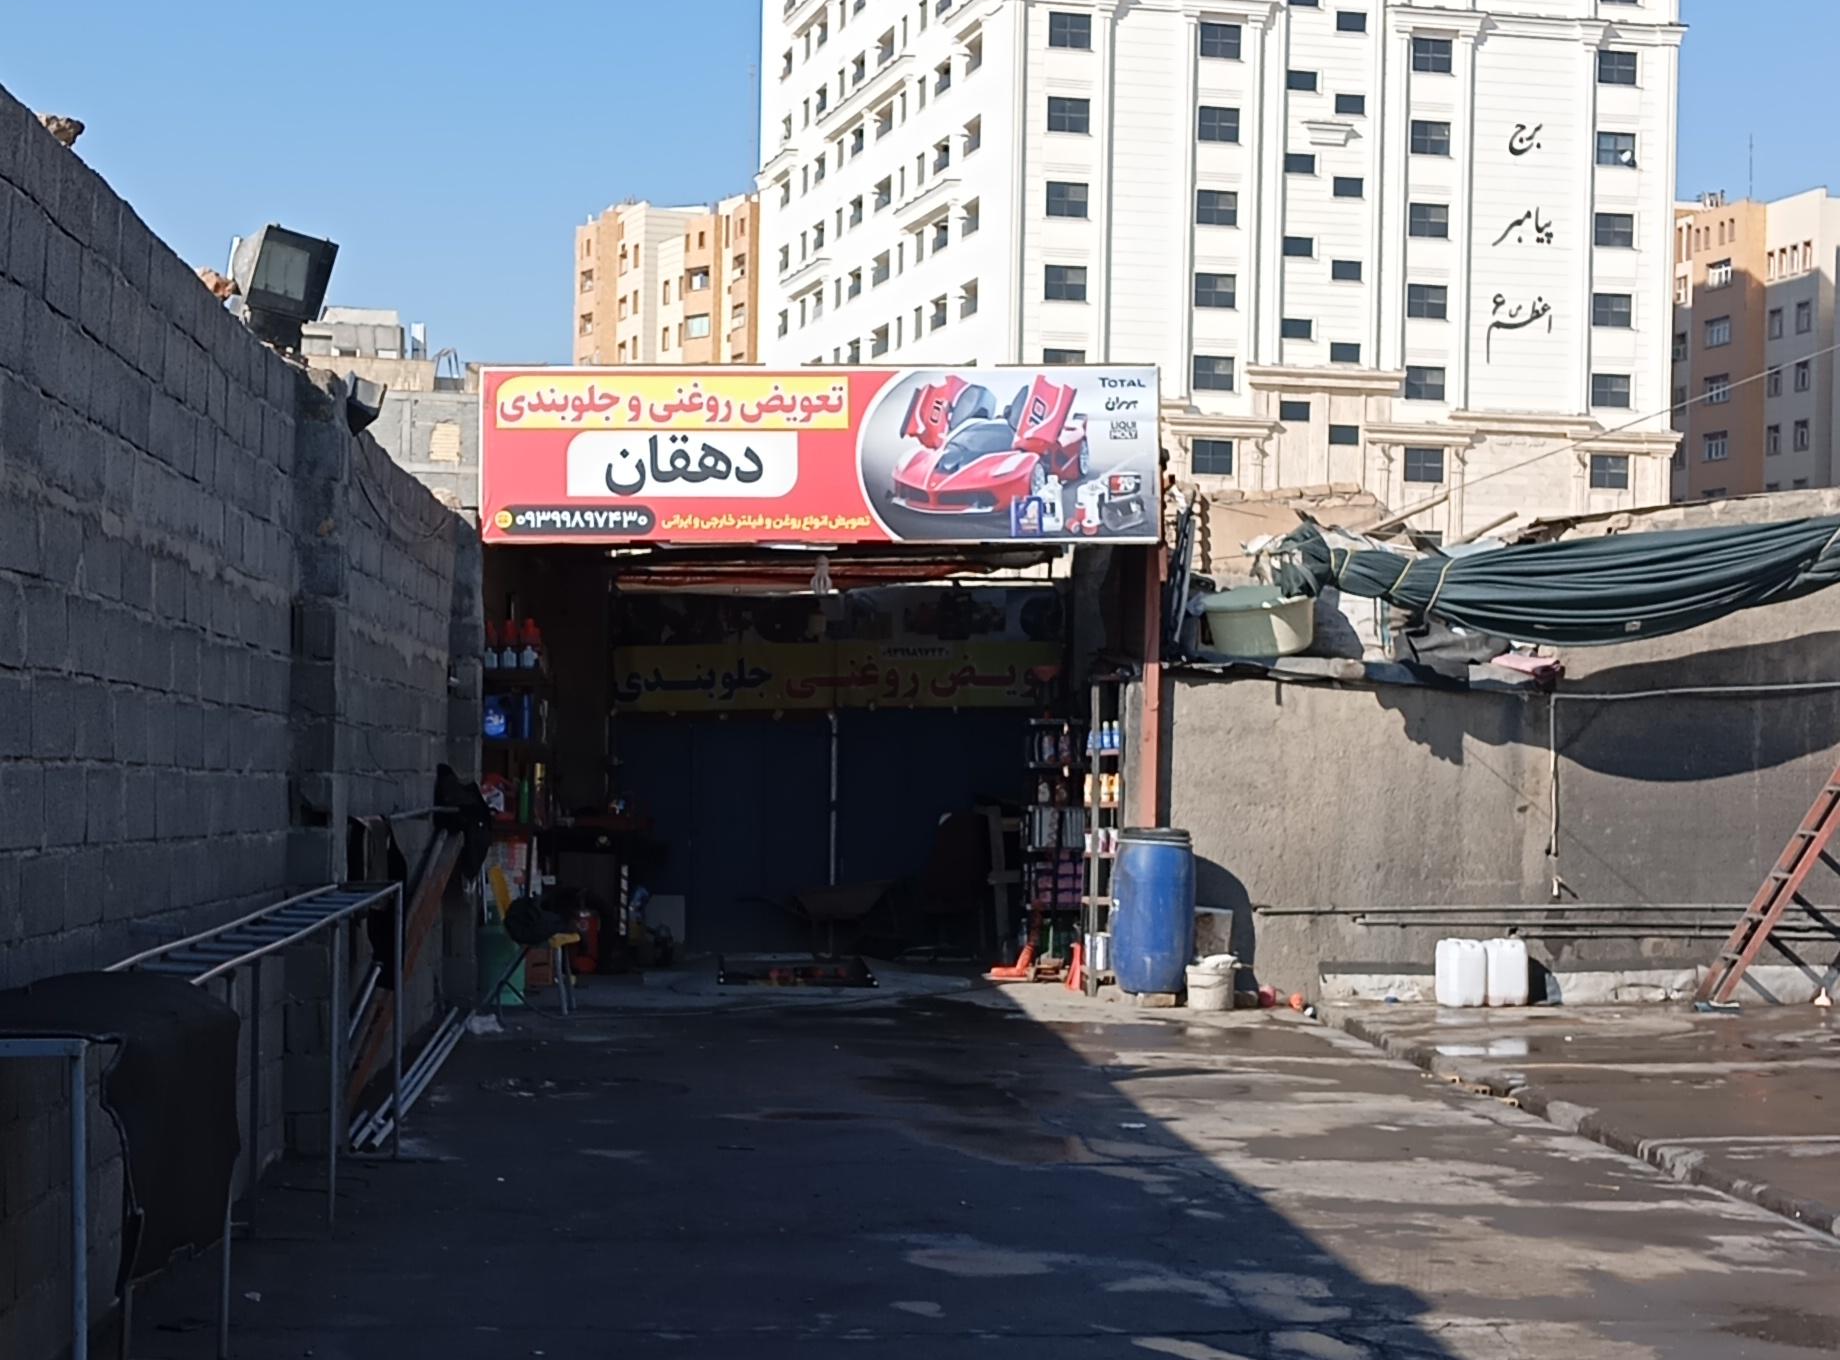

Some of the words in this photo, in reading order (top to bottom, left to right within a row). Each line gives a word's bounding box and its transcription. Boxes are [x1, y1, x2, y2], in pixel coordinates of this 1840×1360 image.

[1508, 123, 1543, 156] برج
[1492, 206, 1553, 247] پیامبر
[1098, 377, 1146, 388] TOTAL
[499, 384, 620, 422] جلوبندی
[628, 395, 642, 422] و
[649, 382, 732, 423] روغنی
[740, 385, 844, 423] تعویض
[605, 434, 764, 497] دهقان
[515, 510, 649, 529] ۰۹۳۹۹۸۹۷۴۳۰
[613, 656, 773, 702] جلوبندی
[931, 653, 1039, 698] ویض
